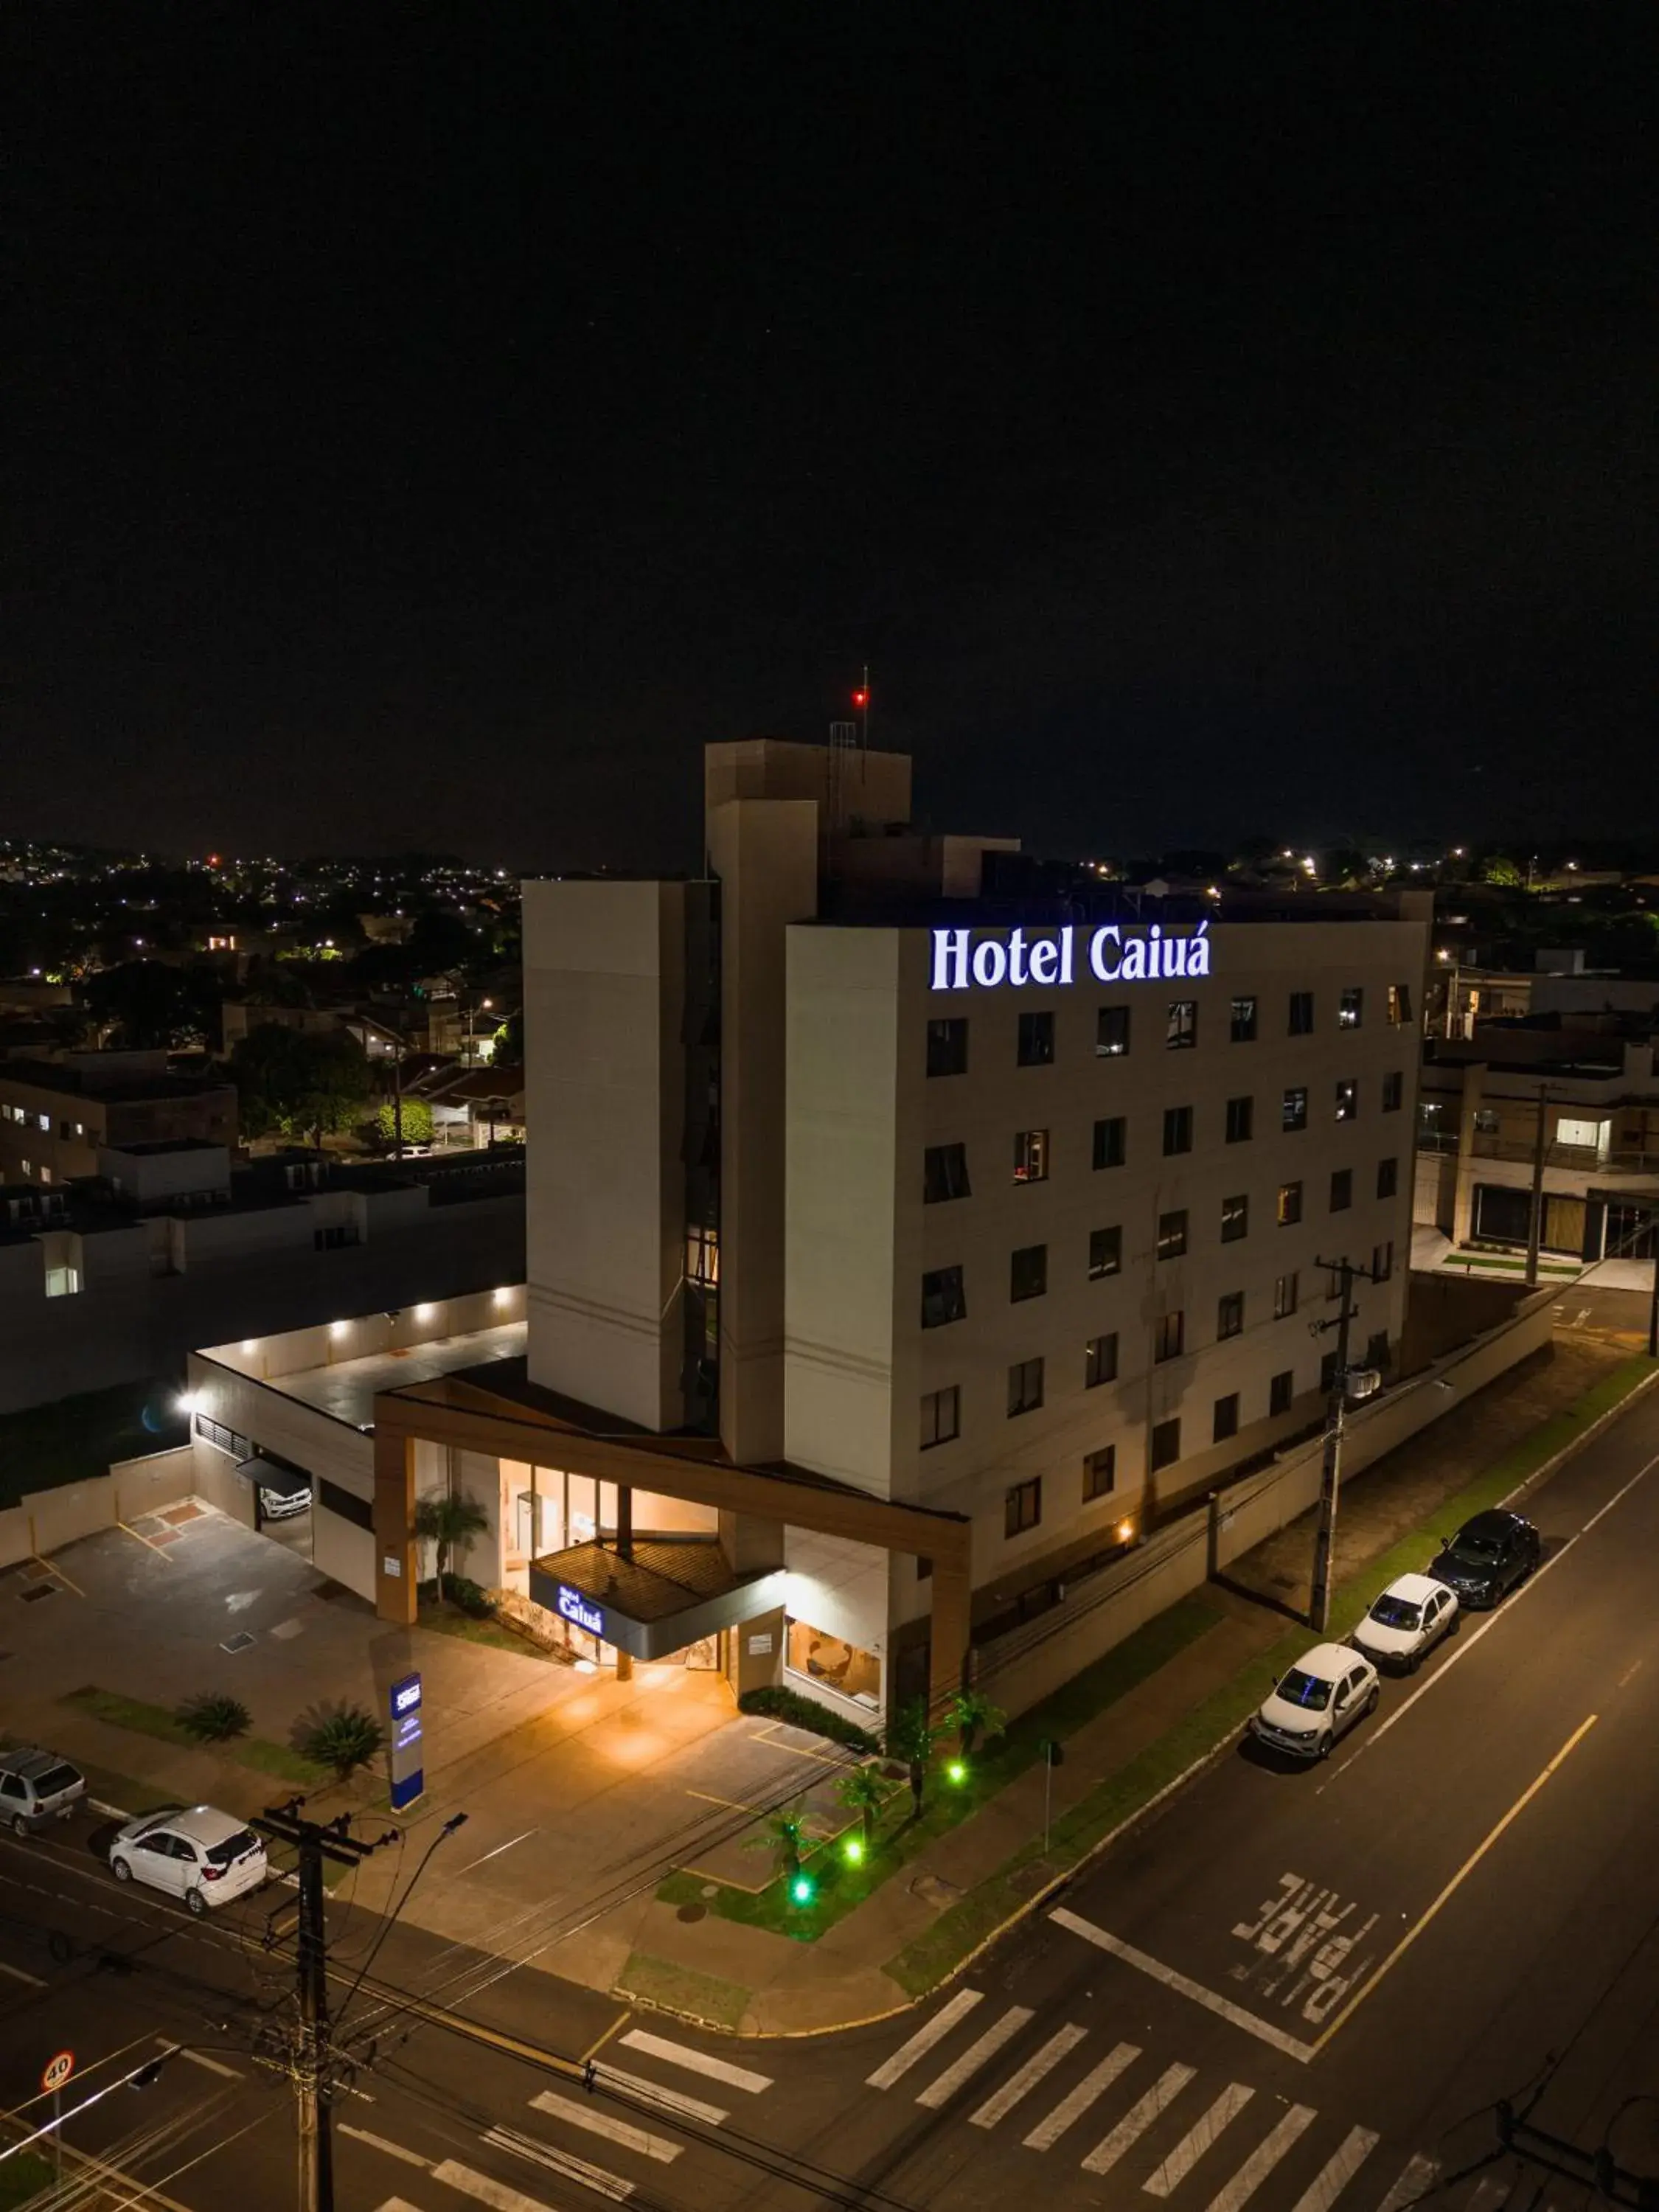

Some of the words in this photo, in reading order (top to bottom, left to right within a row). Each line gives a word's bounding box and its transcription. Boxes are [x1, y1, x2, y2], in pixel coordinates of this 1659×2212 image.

[931, 925, 1074, 990] Hotel
[1090, 919, 1211, 981] Caiuá
[559, 1596, 602, 1633] Caiuá
[1231, 1872, 1380, 1980] PARE
[47, 2058, 69, 2081] 40
